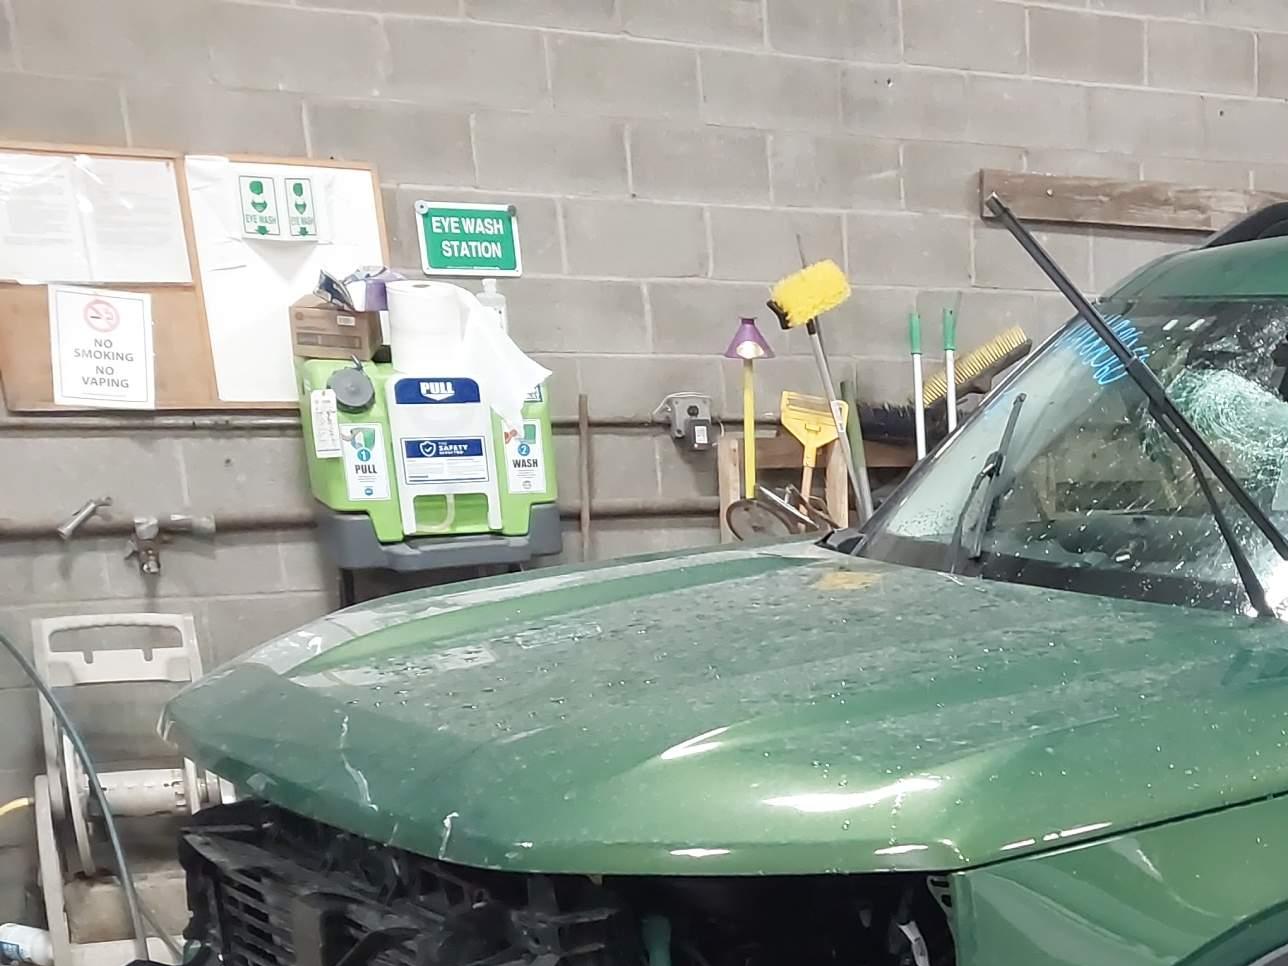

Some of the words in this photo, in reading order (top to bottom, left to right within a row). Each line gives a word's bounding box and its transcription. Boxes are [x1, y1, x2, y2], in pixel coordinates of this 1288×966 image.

[431, 216, 461, 234] EYE
[461, 217, 504, 235] WASH
[441, 240, 503, 258] STATION
[94, 338, 113, 349] NO
[73, 348, 134, 362] SMOKING
[95, 365, 114, 376] NO
[81, 376, 129, 388] VAPING
[420, 382, 455, 394] PULL
[354, 464, 378, 474] PULL
[512, 459, 538, 468] WASH
